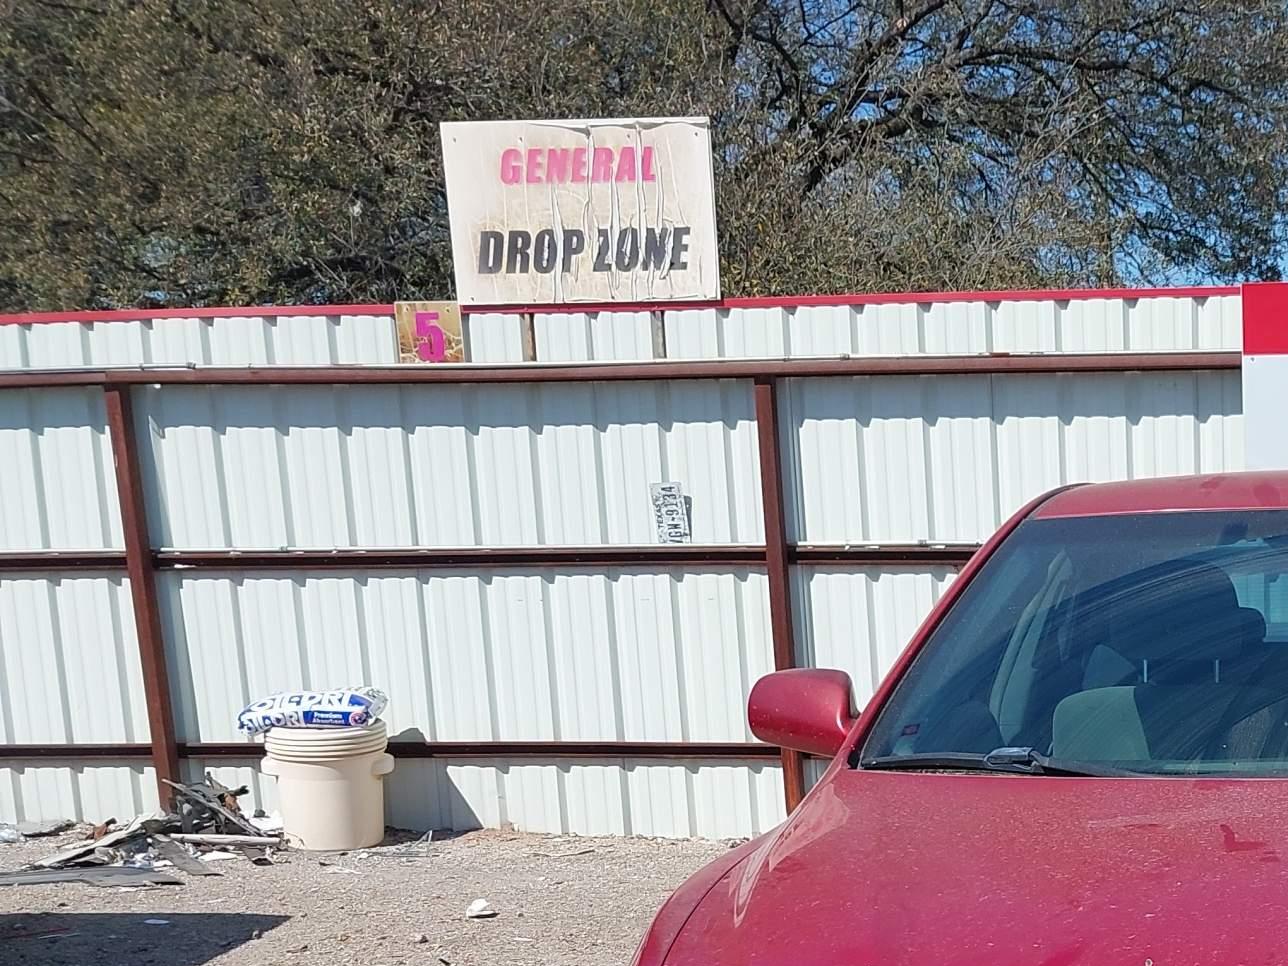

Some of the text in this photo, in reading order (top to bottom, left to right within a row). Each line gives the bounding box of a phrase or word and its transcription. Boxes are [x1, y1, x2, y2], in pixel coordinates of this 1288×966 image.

[500, 146, 657, 185] GENERAL
[478, 227, 691, 275] DROP ZONE
[414, 311, 446, 363] 5
